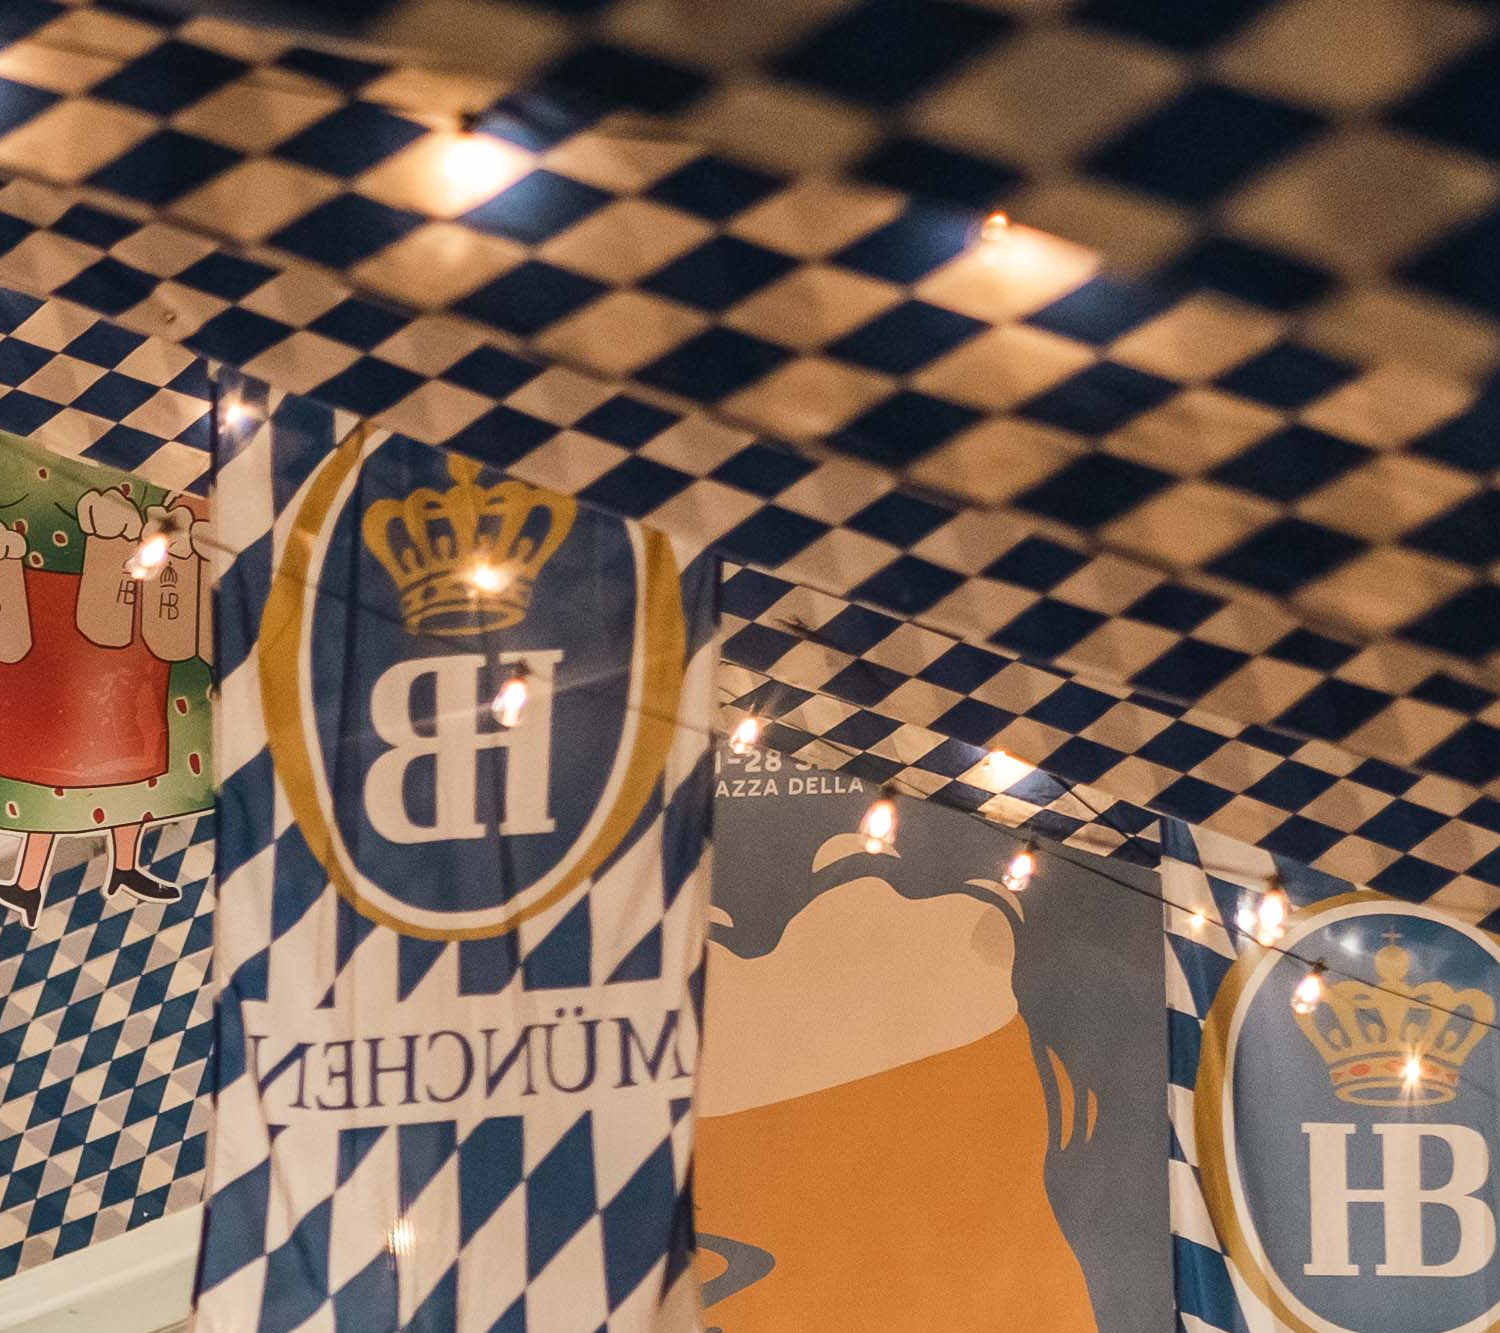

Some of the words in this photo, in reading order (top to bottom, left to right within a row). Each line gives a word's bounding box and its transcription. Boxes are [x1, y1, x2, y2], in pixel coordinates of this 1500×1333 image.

[158, 592, 180, 620] HB
[715, 779, 779, 798] AZZA
[788, 775, 864, 796] DELLA
[1300, 1122, 1497, 1278] HB
